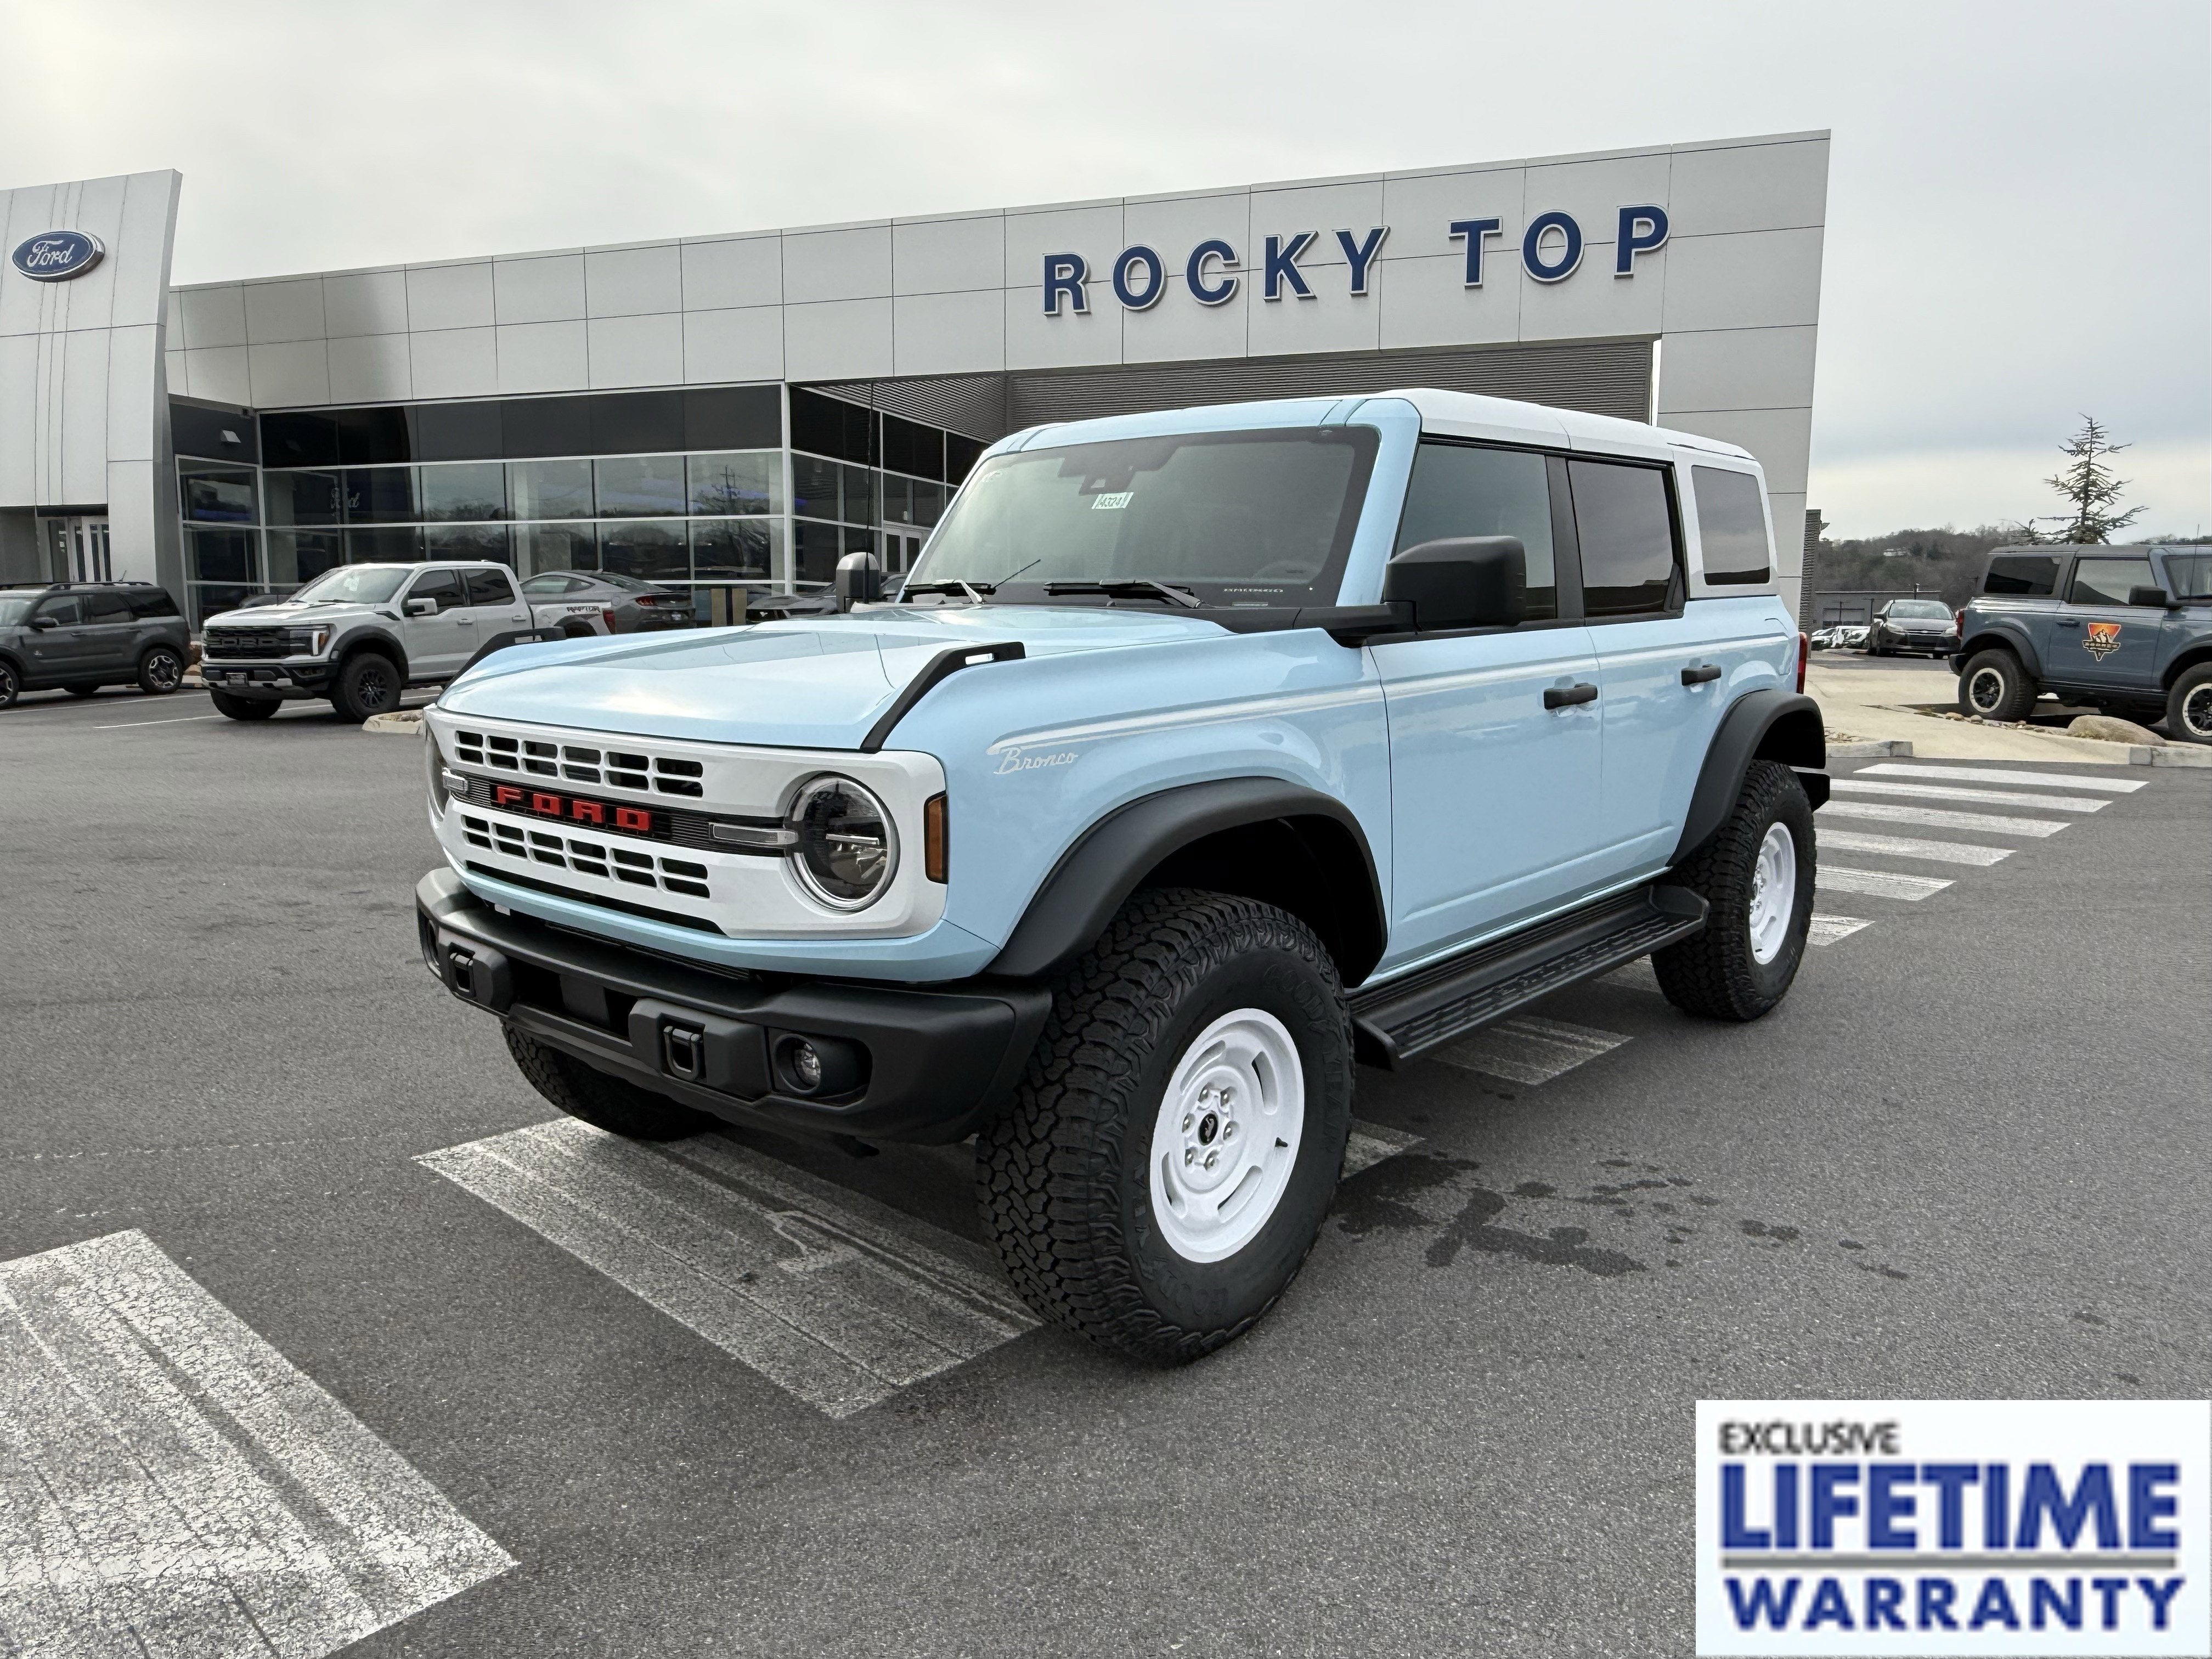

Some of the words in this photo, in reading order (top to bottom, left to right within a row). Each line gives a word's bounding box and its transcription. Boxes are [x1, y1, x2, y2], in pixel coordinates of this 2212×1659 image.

[27, 240, 75, 267] Ford
[1042, 225, 1391, 316] ROCKY
[1448, 204, 1671, 289] TOP
[993, 747, 1079, 775] Bronco
[496, 786, 652, 831] FORD
